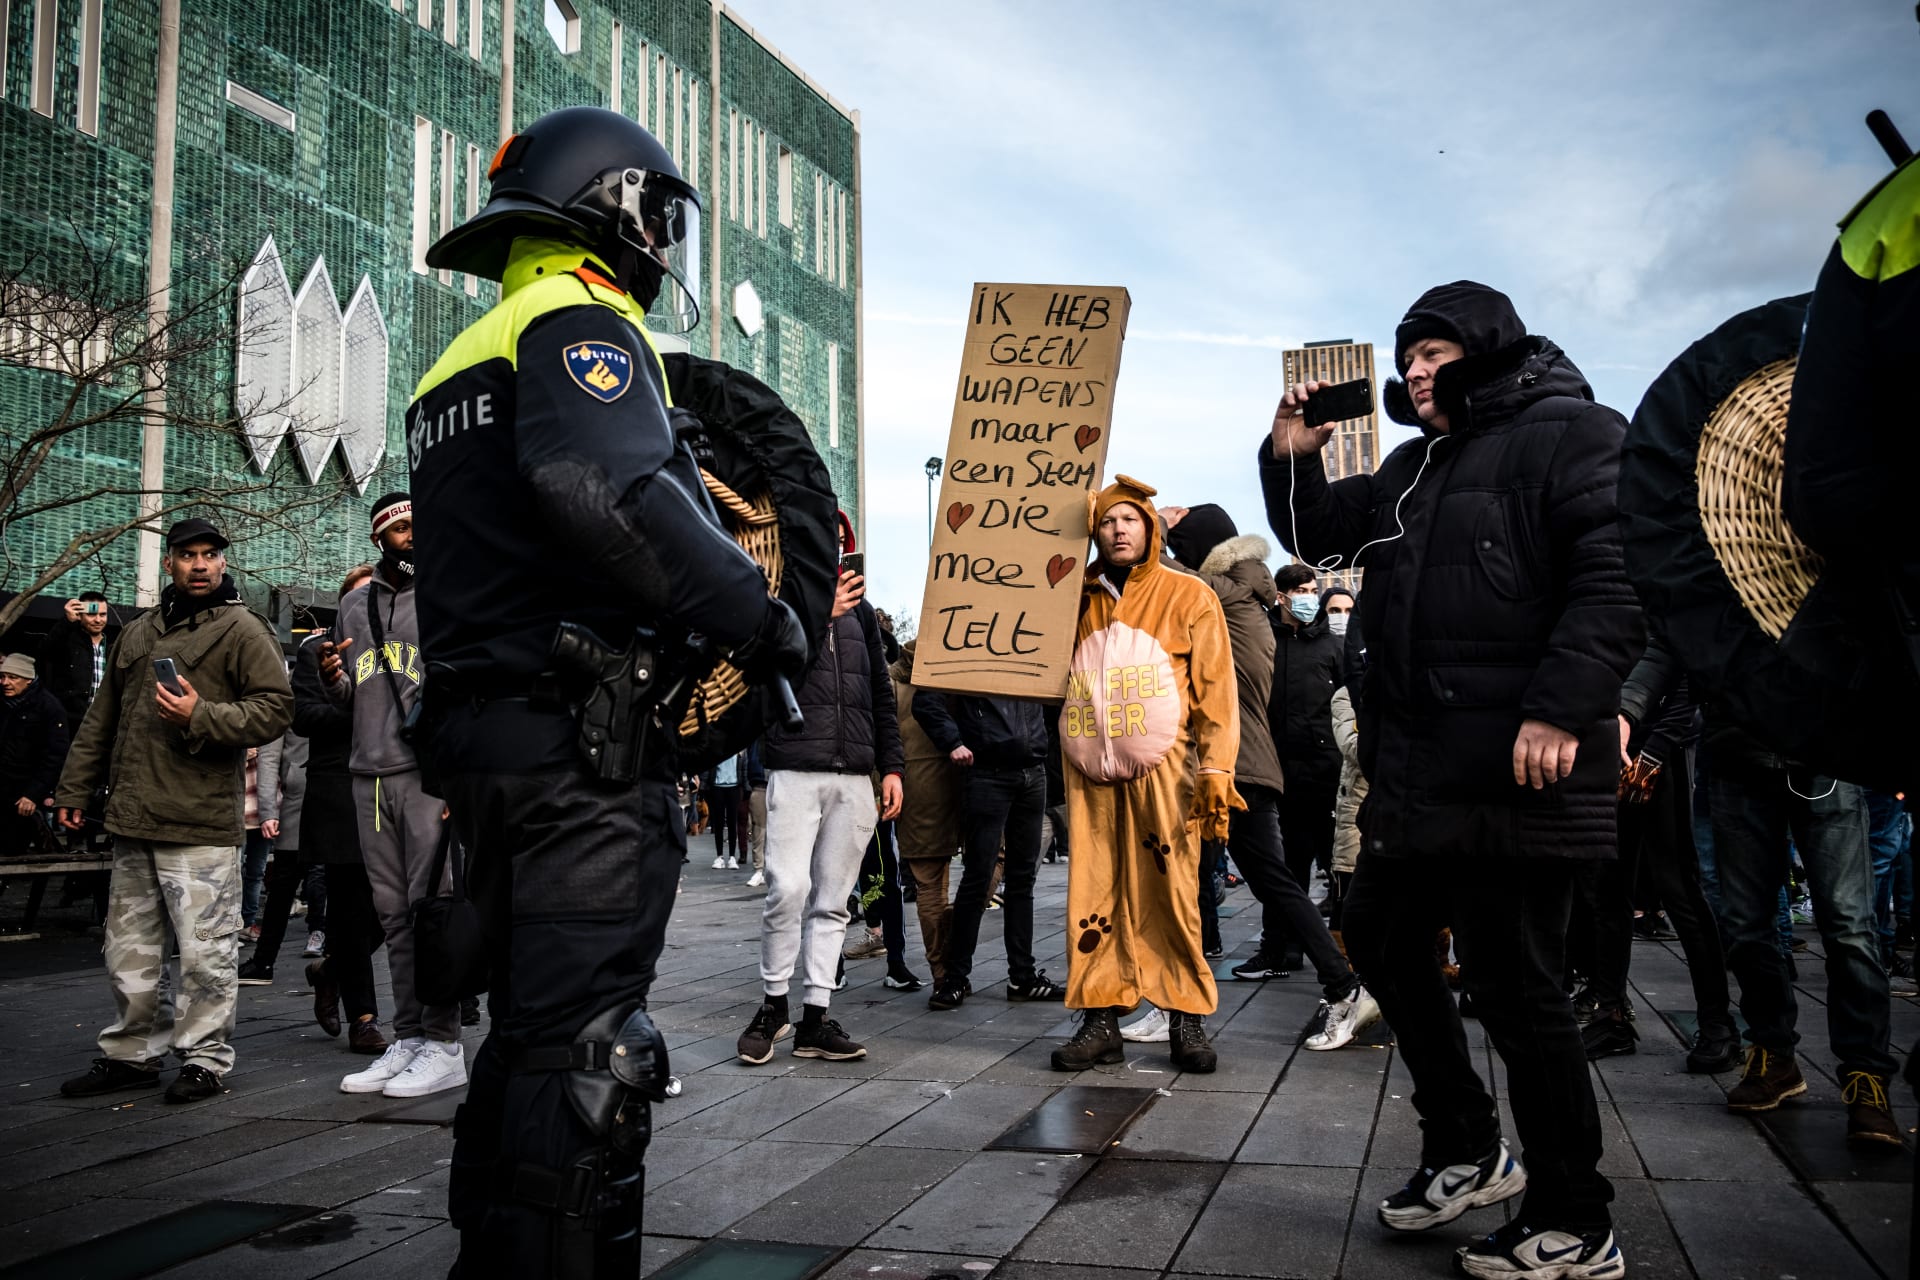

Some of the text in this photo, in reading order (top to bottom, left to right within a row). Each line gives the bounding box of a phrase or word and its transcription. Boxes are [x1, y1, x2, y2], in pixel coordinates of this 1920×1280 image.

[1044, 293, 1111, 333] HEB
[990, 333, 1089, 367] GEEN
[962, 374, 1105, 408] WAPENS
[970, 418, 1071, 444] maar
[950, 459, 1014, 488] een
[978, 496, 1061, 536] Die
